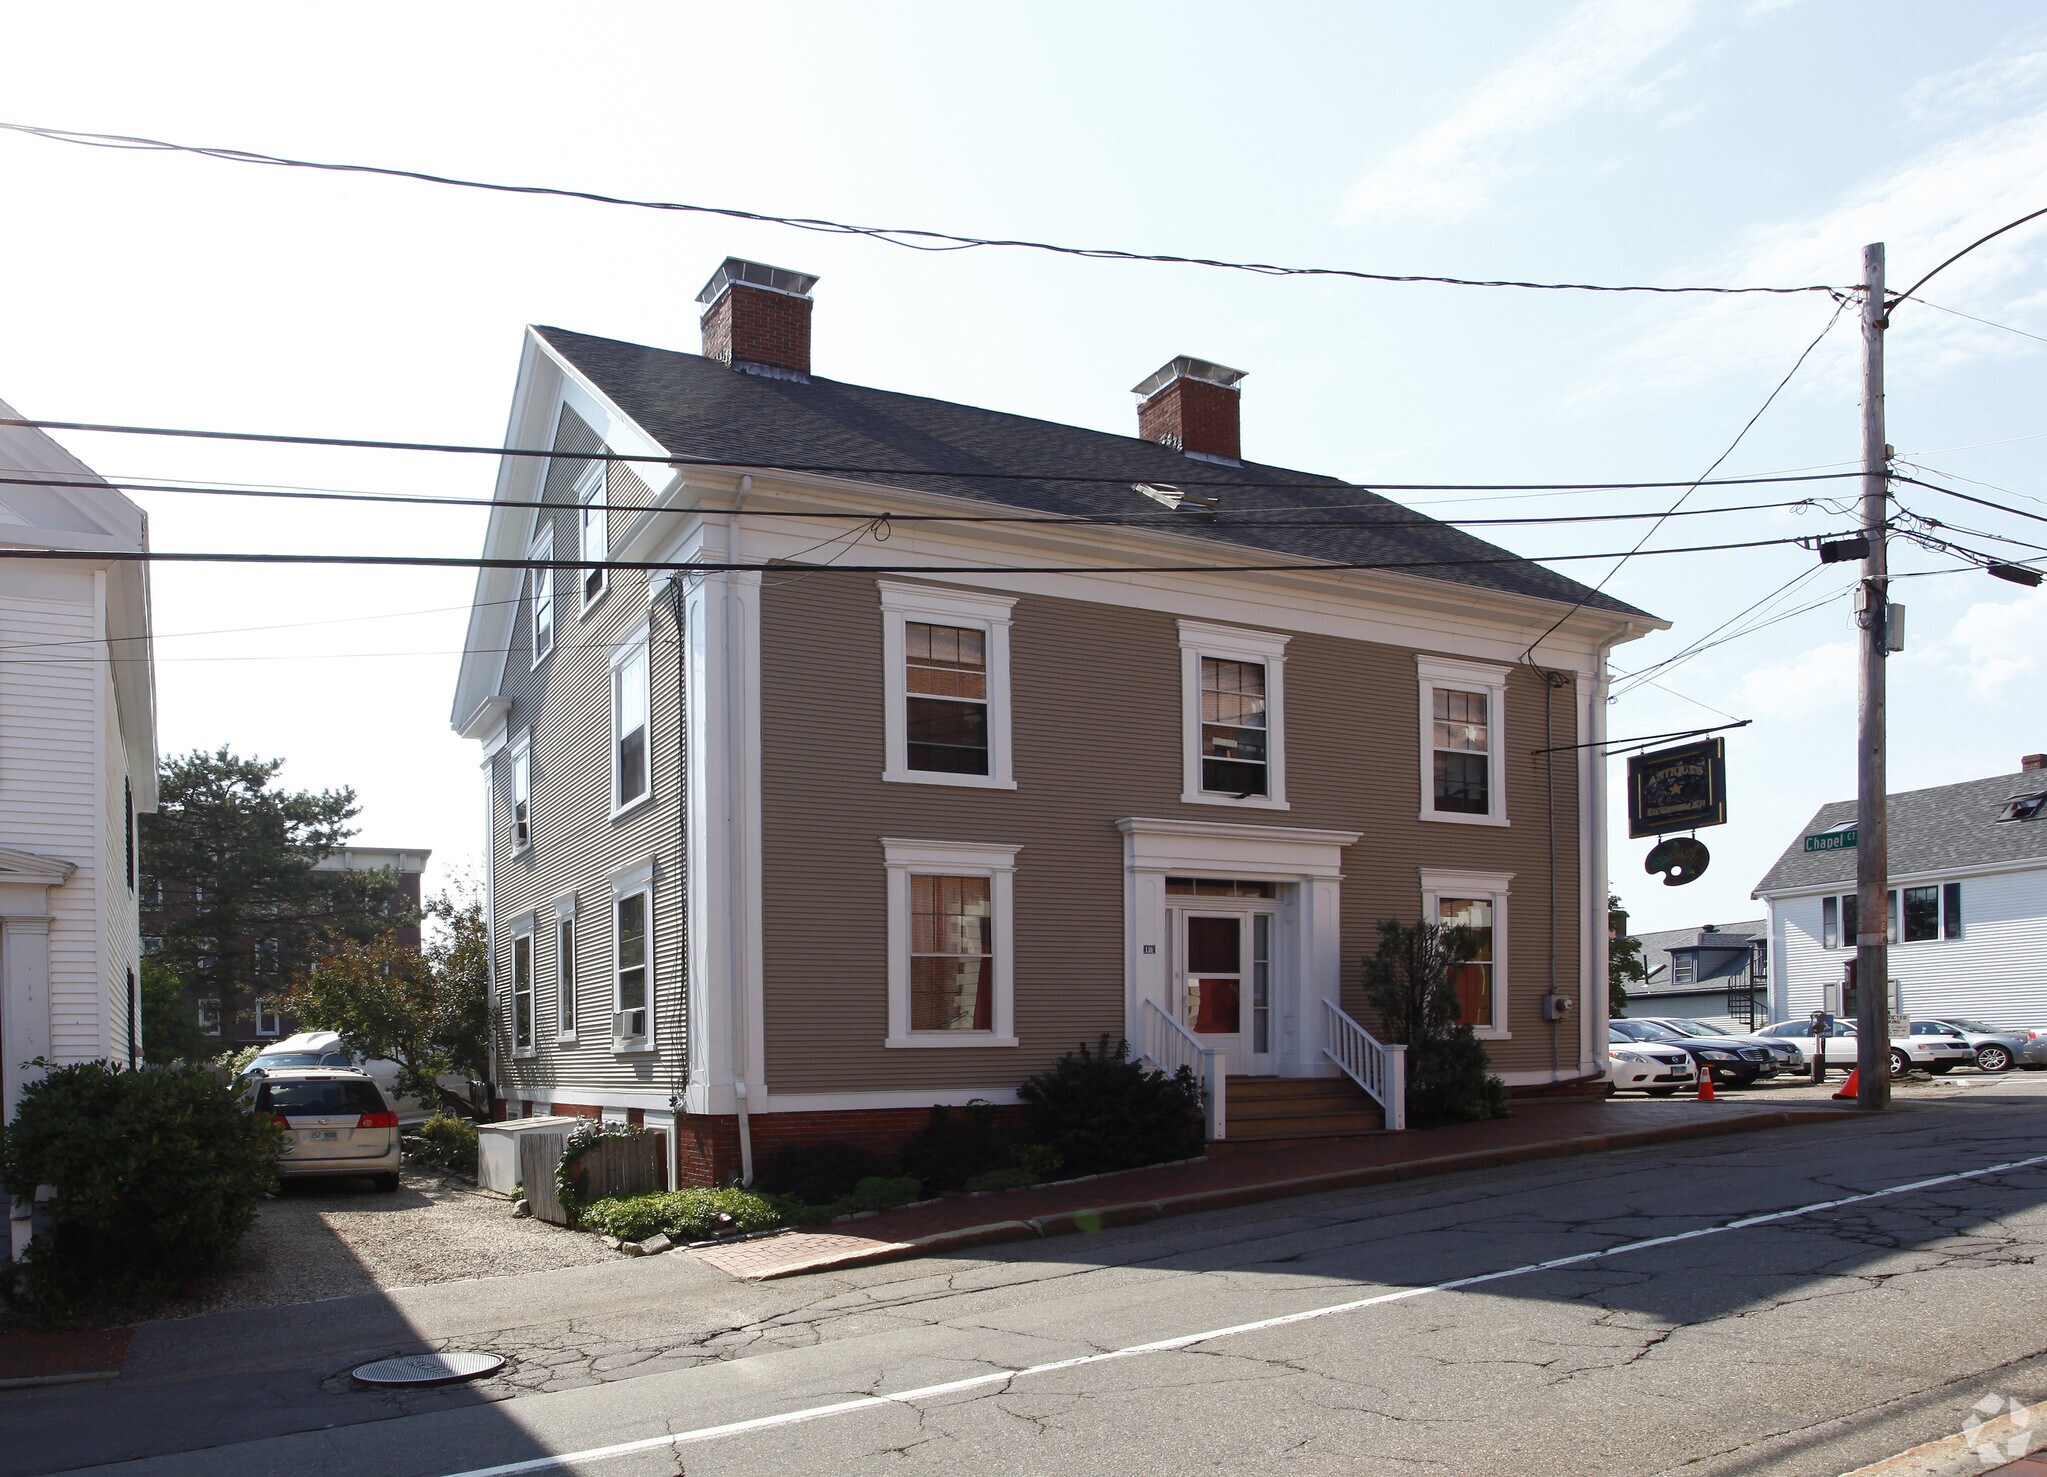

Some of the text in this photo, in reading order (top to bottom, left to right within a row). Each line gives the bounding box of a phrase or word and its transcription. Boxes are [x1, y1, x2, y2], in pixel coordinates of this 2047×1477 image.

[1648, 765, 1704, 786] ANTIQUES
[1806, 832, 1856, 851] Chapel CT
